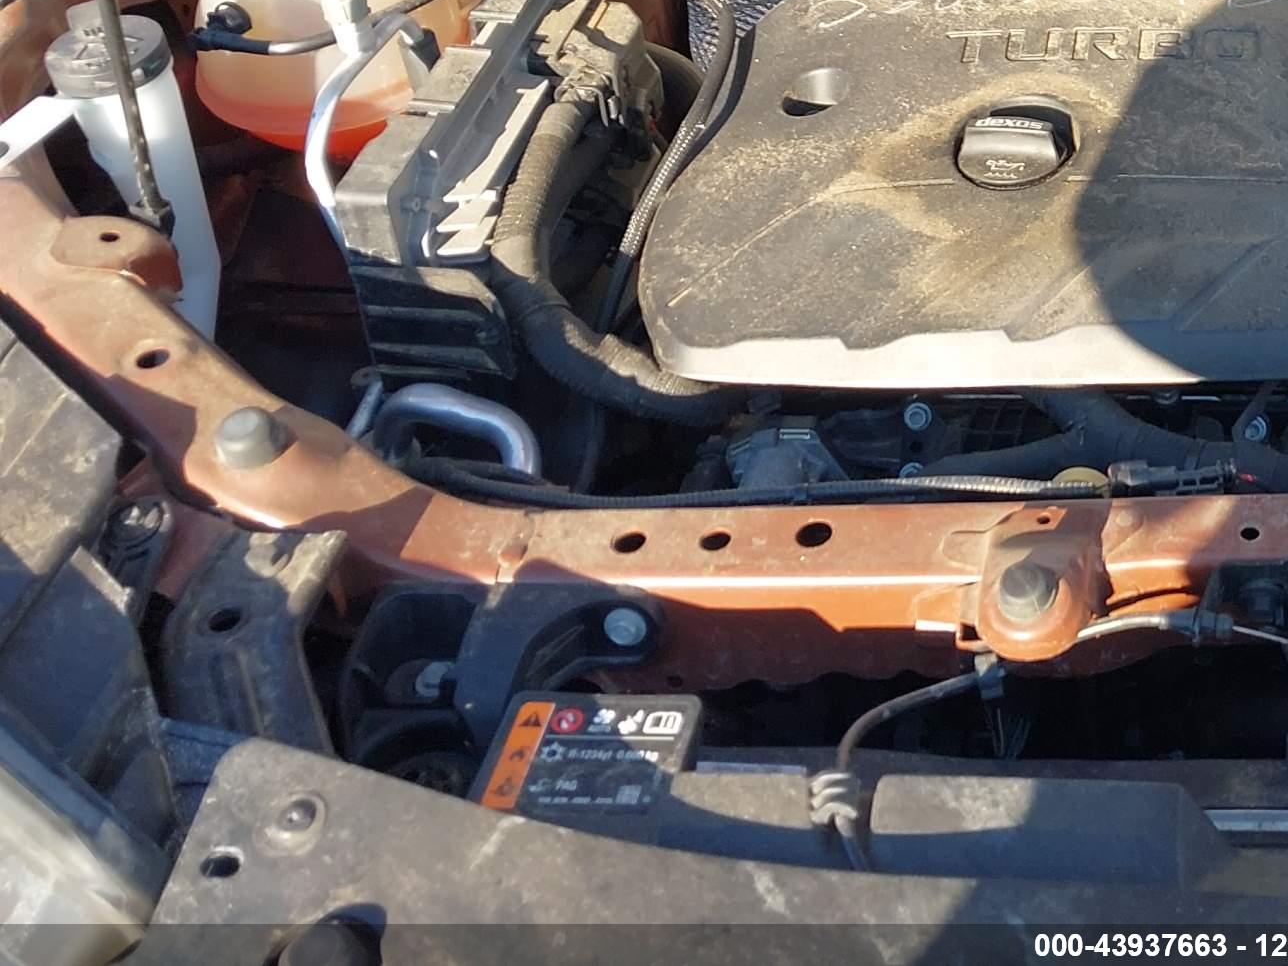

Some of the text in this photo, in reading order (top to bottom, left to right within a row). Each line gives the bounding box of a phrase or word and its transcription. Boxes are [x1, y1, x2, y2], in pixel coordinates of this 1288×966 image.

[946, 27, 1260, 64] TURBO
[975, 117, 1044, 130] dexos
[568, 749, 612, 762] R-1234yf
[556, 779, 578, 791] PAG
